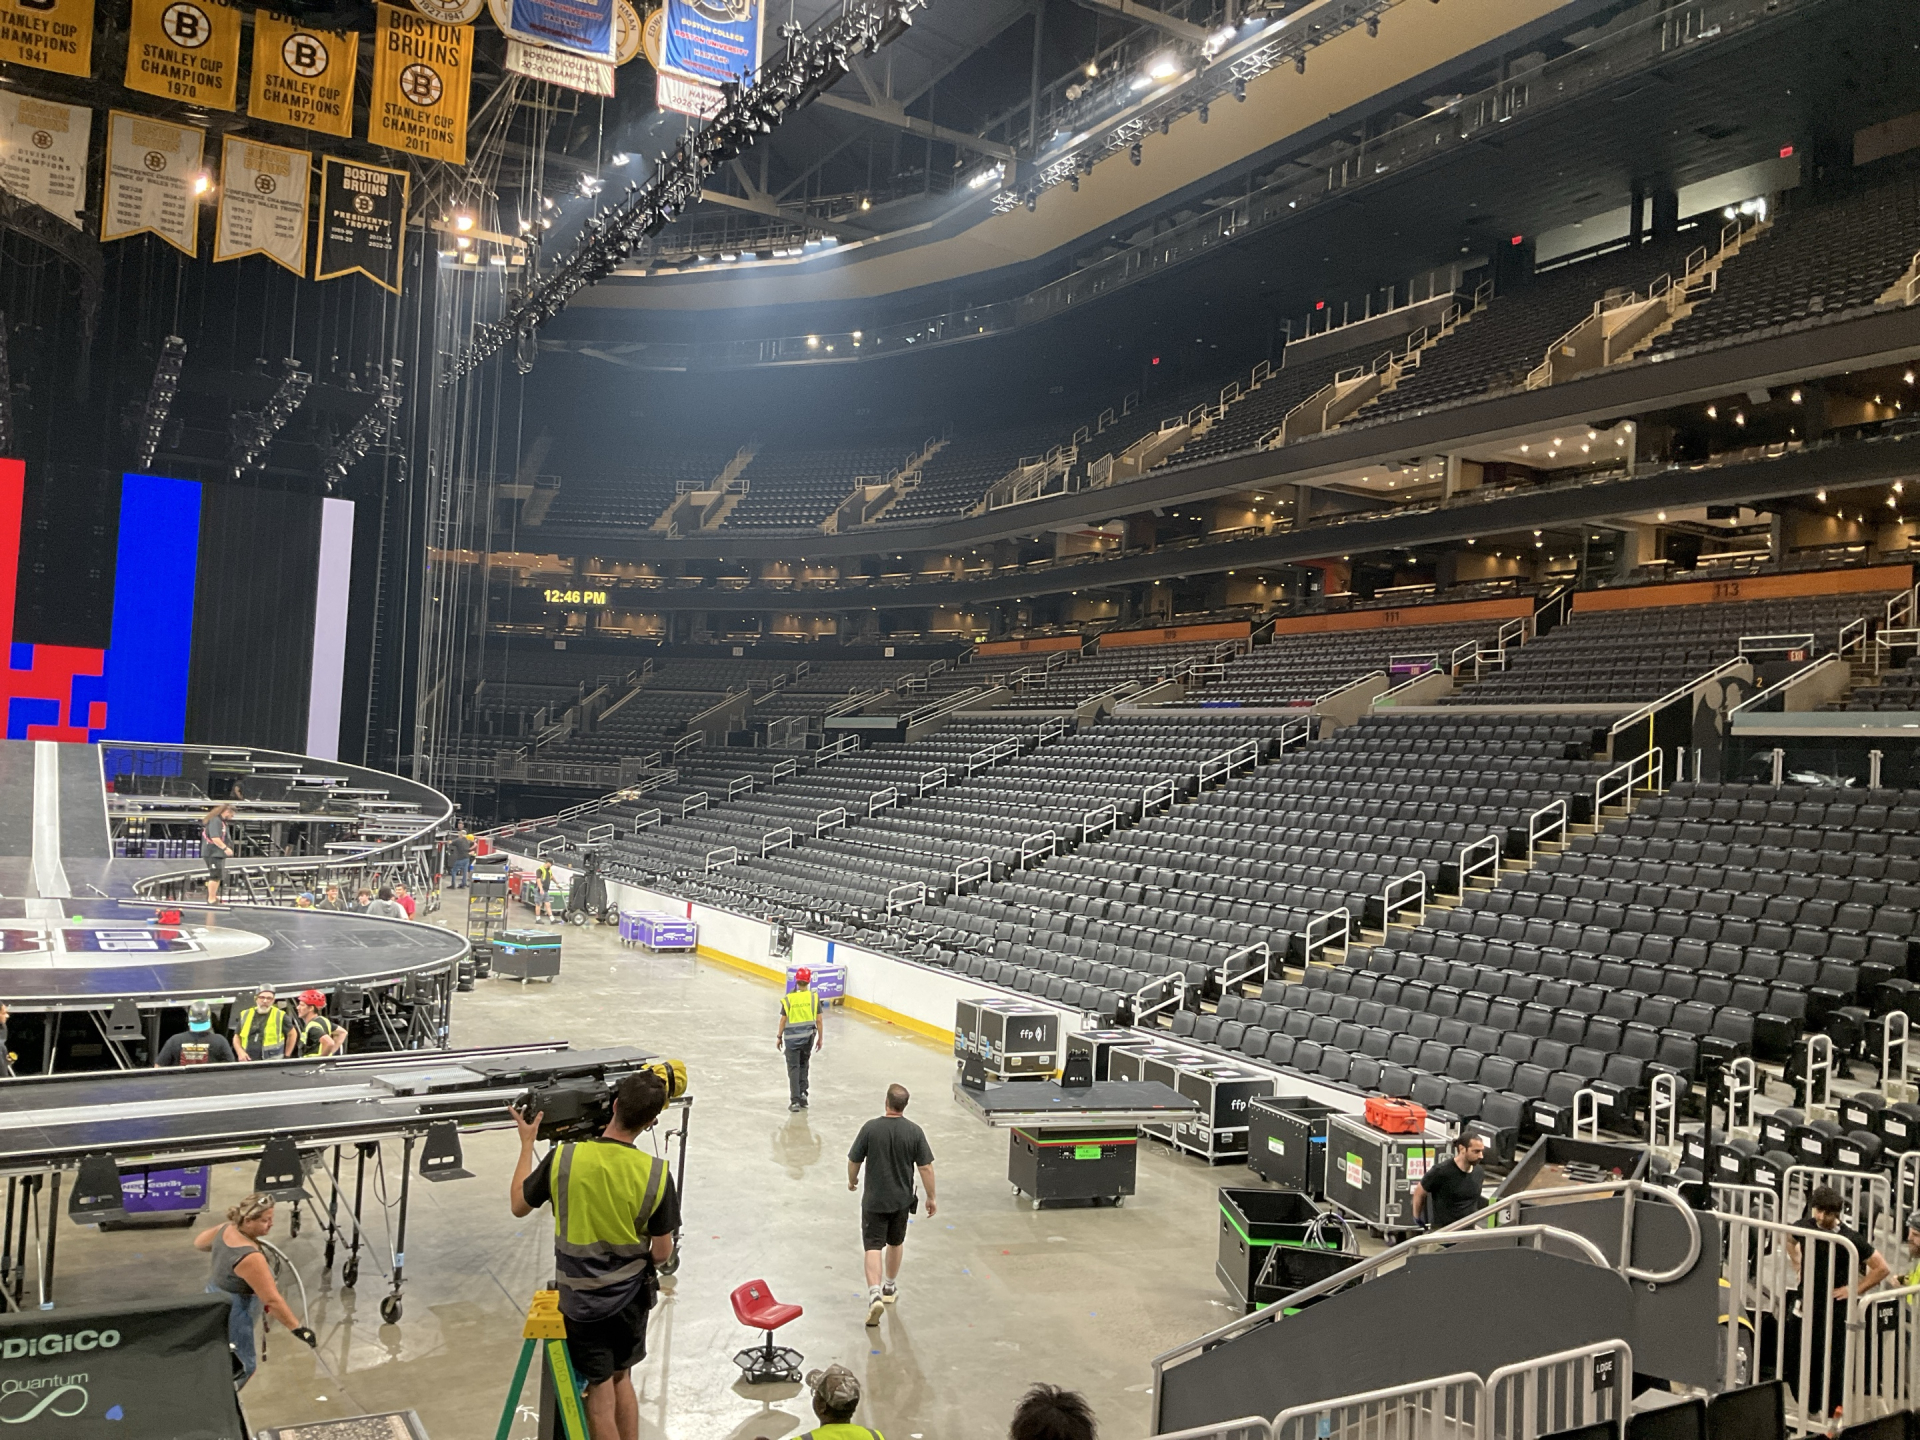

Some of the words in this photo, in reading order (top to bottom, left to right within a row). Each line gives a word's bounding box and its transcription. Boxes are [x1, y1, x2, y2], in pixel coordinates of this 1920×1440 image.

[419, 0, 466, 21] 1927-1947
[559, 4, 604, 21] UNIVERSITY
[0, 11, 49, 32] TANLEY
[53, 22, 77, 38] CUP
[390, 10, 462, 46] BOSTON
[543, 13, 583, 29] HARVARD
[681, 18, 712, 34] BOSTON
[712, 27, 744, 43] COLLEGE
[0, 27, 77, 54] HAMPIONS
[388, 32, 460, 67] BRUINS
[675, 29, 705, 44] BOSTON
[707, 38, 749, 57] UNIVERSITY
[18, 46, 48, 64] 1941
[143, 44, 198, 67] STANLEY
[200, 58, 223, 73] CUP
[523, 49, 560, 65] BOSTON
[563, 59, 600, 75] COLLEGE
[694, 48, 730, 64] HARVARD
[141, 59, 223, 89] CHAMPIONS
[520, 60, 544, 73] 2026
[546, 65, 601, 87] CHAMPIONS
[682, 58, 735, 79] NORTHEASTER
[168, 81, 197, 98] 1970
[265, 74, 316, 95] STANLEY
[318, 86, 341, 101] CUP
[263, 88, 341, 116] CHAMPIONS
[671, 96, 693, 109] 2026
[288, 109, 316, 126] 1972
[384, 103, 431, 124] STANLEY
[434, 115, 455, 129] CUP
[382, 116, 454, 144] CHAMPIONS
[405, 137, 430, 153] 2011
[10, 154, 71, 172] CHAMPIONS
[18, 148, 65, 163] DIVISION
[112, 164, 155, 176] CONFERENCE
[344, 166, 388, 186] BOSTON
[147, 178, 169, 188] WALES
[343, 178, 387, 197] BRUINS
[225, 188, 265, 201] CONFERENCE
[267, 196, 303, 209] CHAMPIONS
[258, 200, 278, 210] WALES
[345, 219, 380, 232] TROPHY
[544, 589, 580, 604] 12:46
[583, 591, 607, 605] PM
[1716, 582, 1739, 597] 113
[1385, 611, 1400, 622] 111
[1790, 650, 1804, 661] EXIT
[1756, 677, 1763, 688] 2
[1020, 1029, 1034, 1040] ffp
[1231, 1099, 1247, 1111] ffp
[1880, 1307, 1893, 1318] LOGE
[3, 1329, 121, 1358] DiGiCo
[1596, 1360, 1613, 1374] LOGE
[1, 1372, 89, 1394] Quantum
